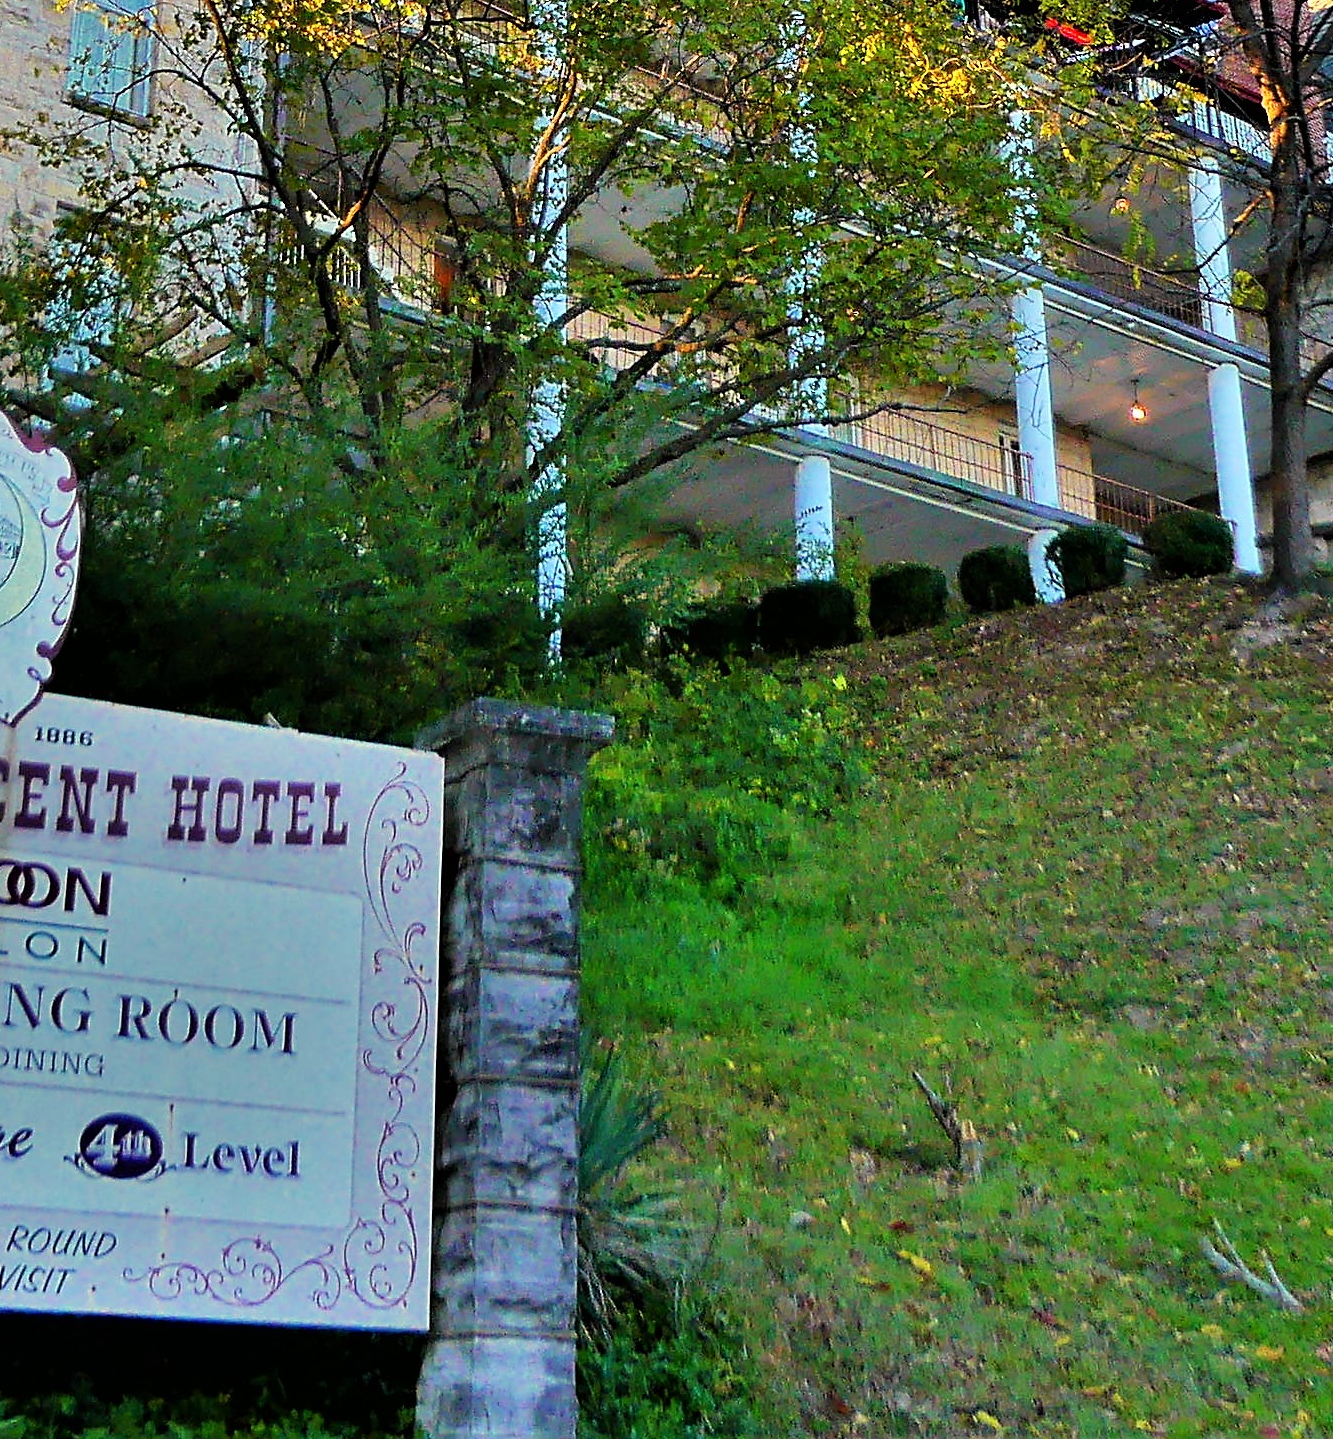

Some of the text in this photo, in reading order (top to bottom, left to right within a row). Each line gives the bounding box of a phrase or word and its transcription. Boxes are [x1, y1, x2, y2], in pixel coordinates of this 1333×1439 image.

[34, 726, 94, 747] 1886
[167, 775, 349, 846] HOTEL
[115, 992, 299, 1055] ROOM
[182, 1130, 301, 1179] Level
[7, 1225, 119, 1257] ROUND
